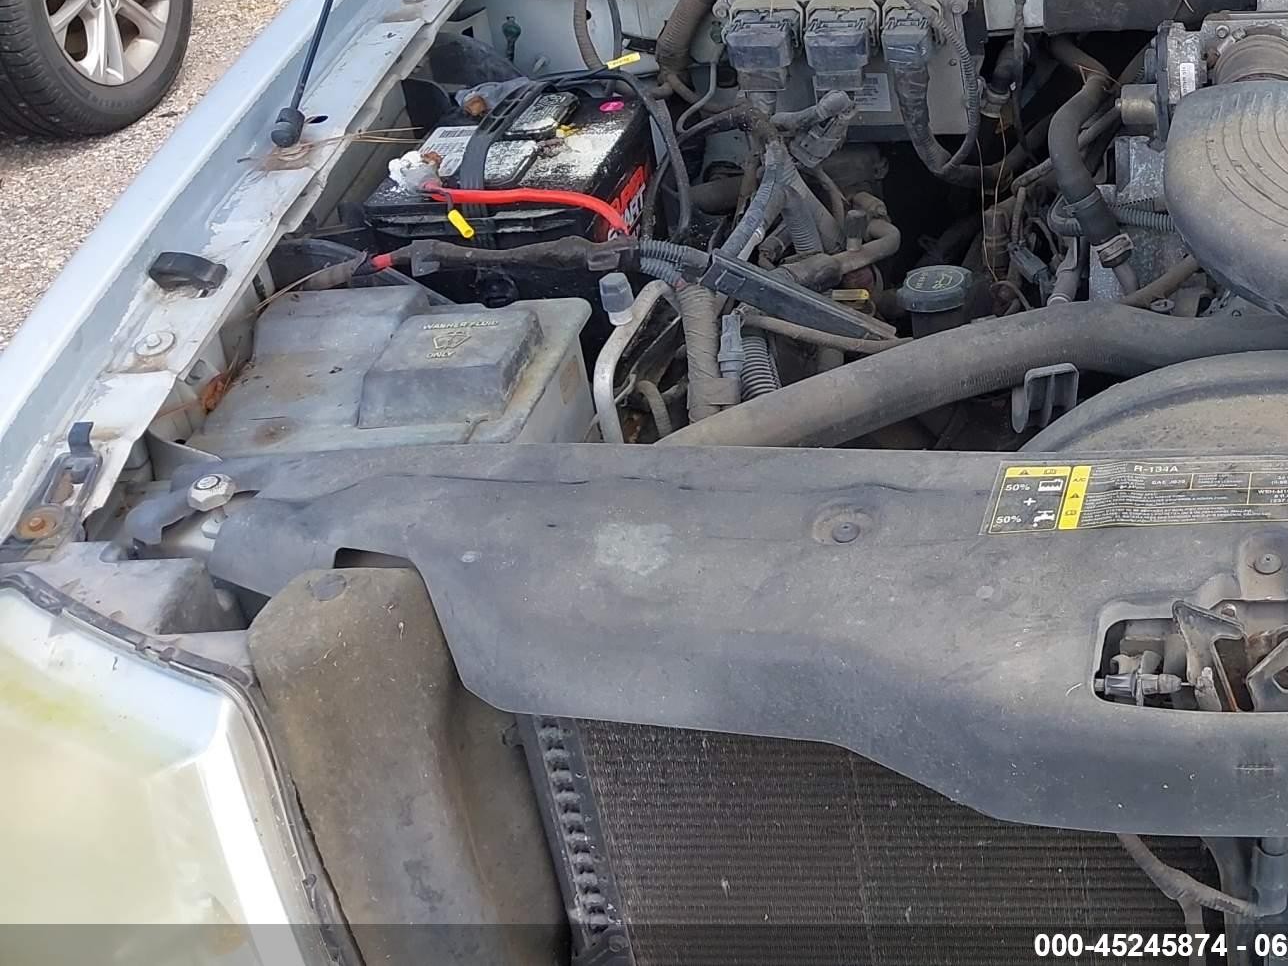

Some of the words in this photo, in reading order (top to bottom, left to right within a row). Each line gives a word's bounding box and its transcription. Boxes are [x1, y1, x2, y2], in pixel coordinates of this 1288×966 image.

[426, 351, 455, 359] ONLY
[1133, 464, 1179, 474] R-134A
[1004, 483, 1031, 491] 50%
[996, 515, 1022, 524] 50%
